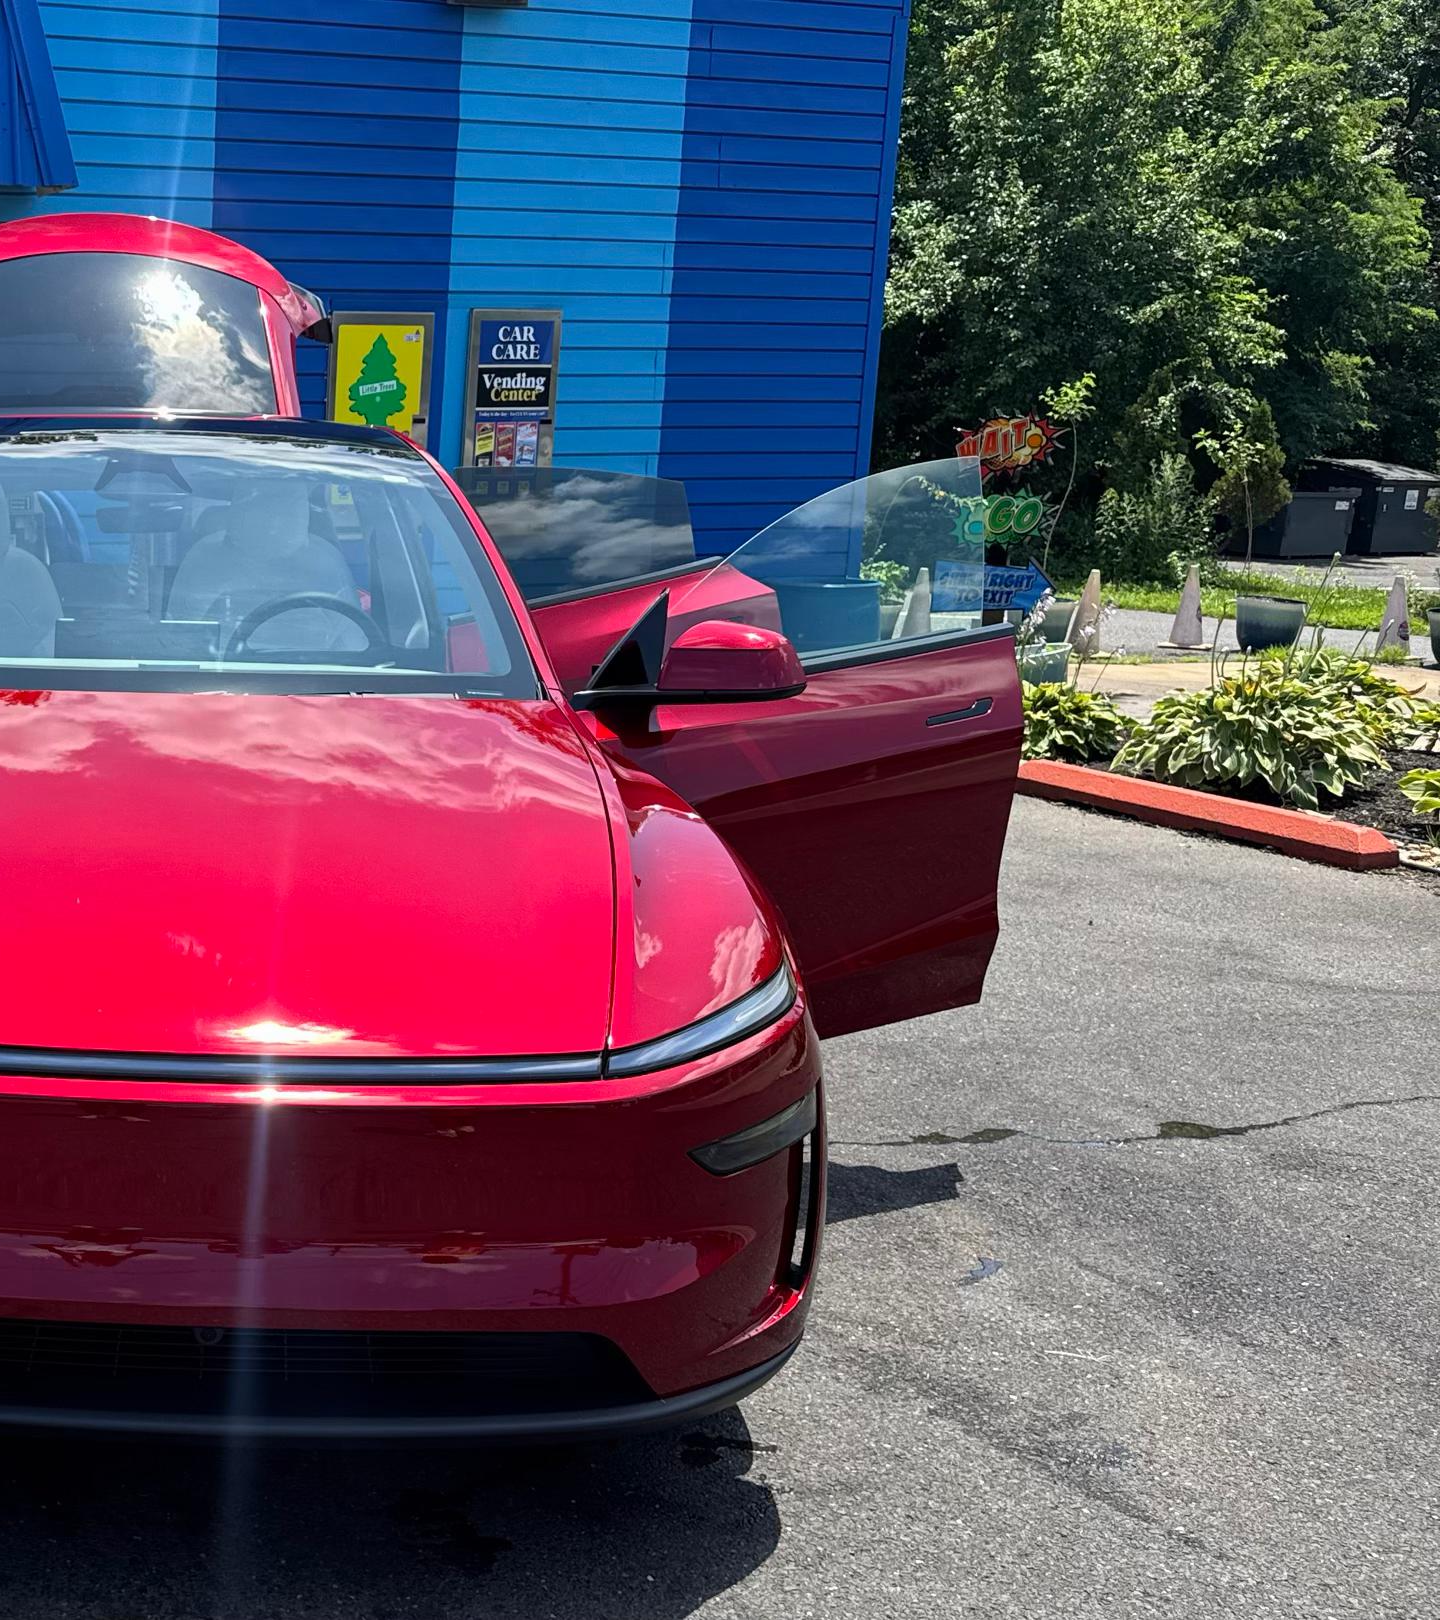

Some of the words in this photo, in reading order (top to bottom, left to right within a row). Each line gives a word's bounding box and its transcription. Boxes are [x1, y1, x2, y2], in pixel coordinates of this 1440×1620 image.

[498, 325, 536, 342] CAR
[491, 343, 541, 361] CARE
[361, 385, 378, 395] Little
[379, 382, 395, 392] Trees
[482, 372, 547, 394] Vending
[490, 387, 538, 402] Center
[956, 419, 1031, 461] WAIT
[988, 496, 1043, 533] GO
[988, 572, 1036, 590] RIGHT
[983, 589, 1014, 605] EXIT
